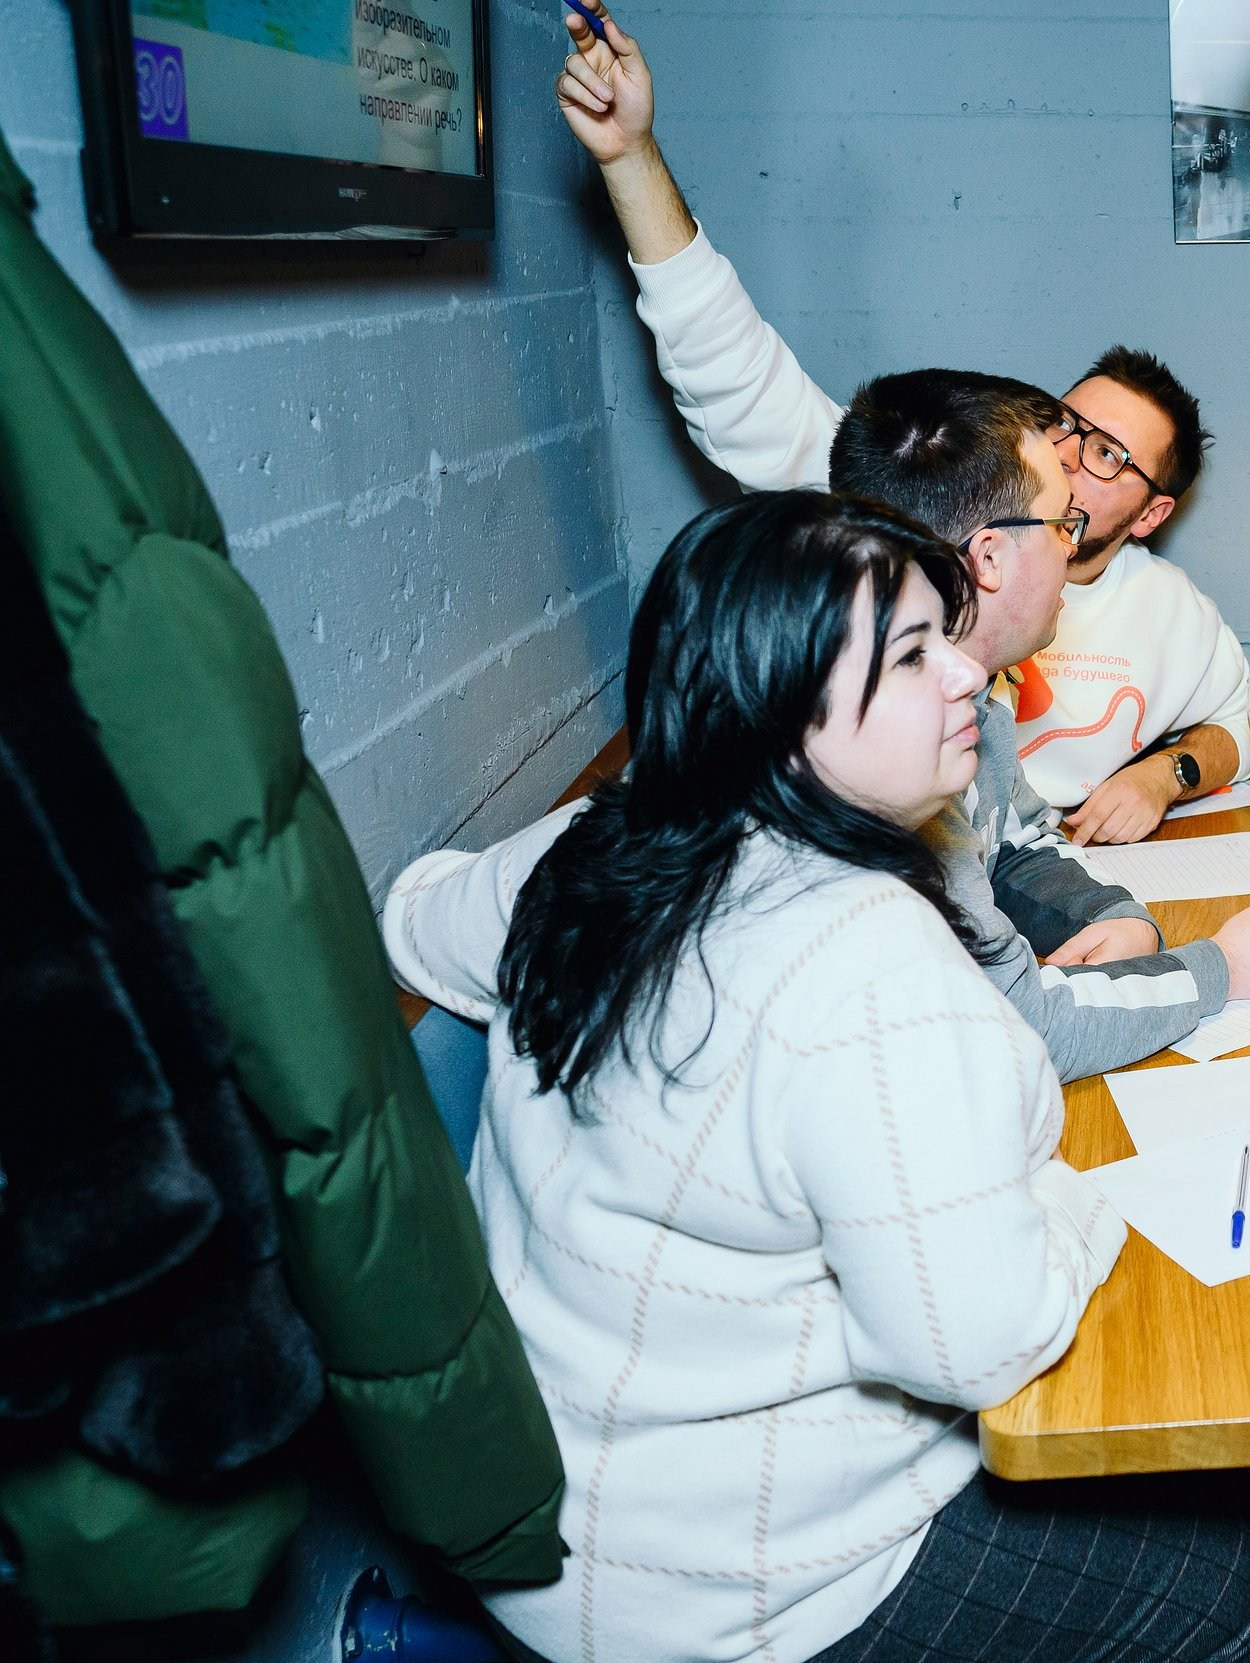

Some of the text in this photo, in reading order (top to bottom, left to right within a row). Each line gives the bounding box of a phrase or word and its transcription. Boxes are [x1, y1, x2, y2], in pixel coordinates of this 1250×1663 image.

[136, 50, 186, 127] 30
[358, 46, 417, 81] искусстве.
[431, 65, 460, 91] каком
[359, 93, 463, 135] направлении речь?
[1037, 651, 1131, 667] мобильность
